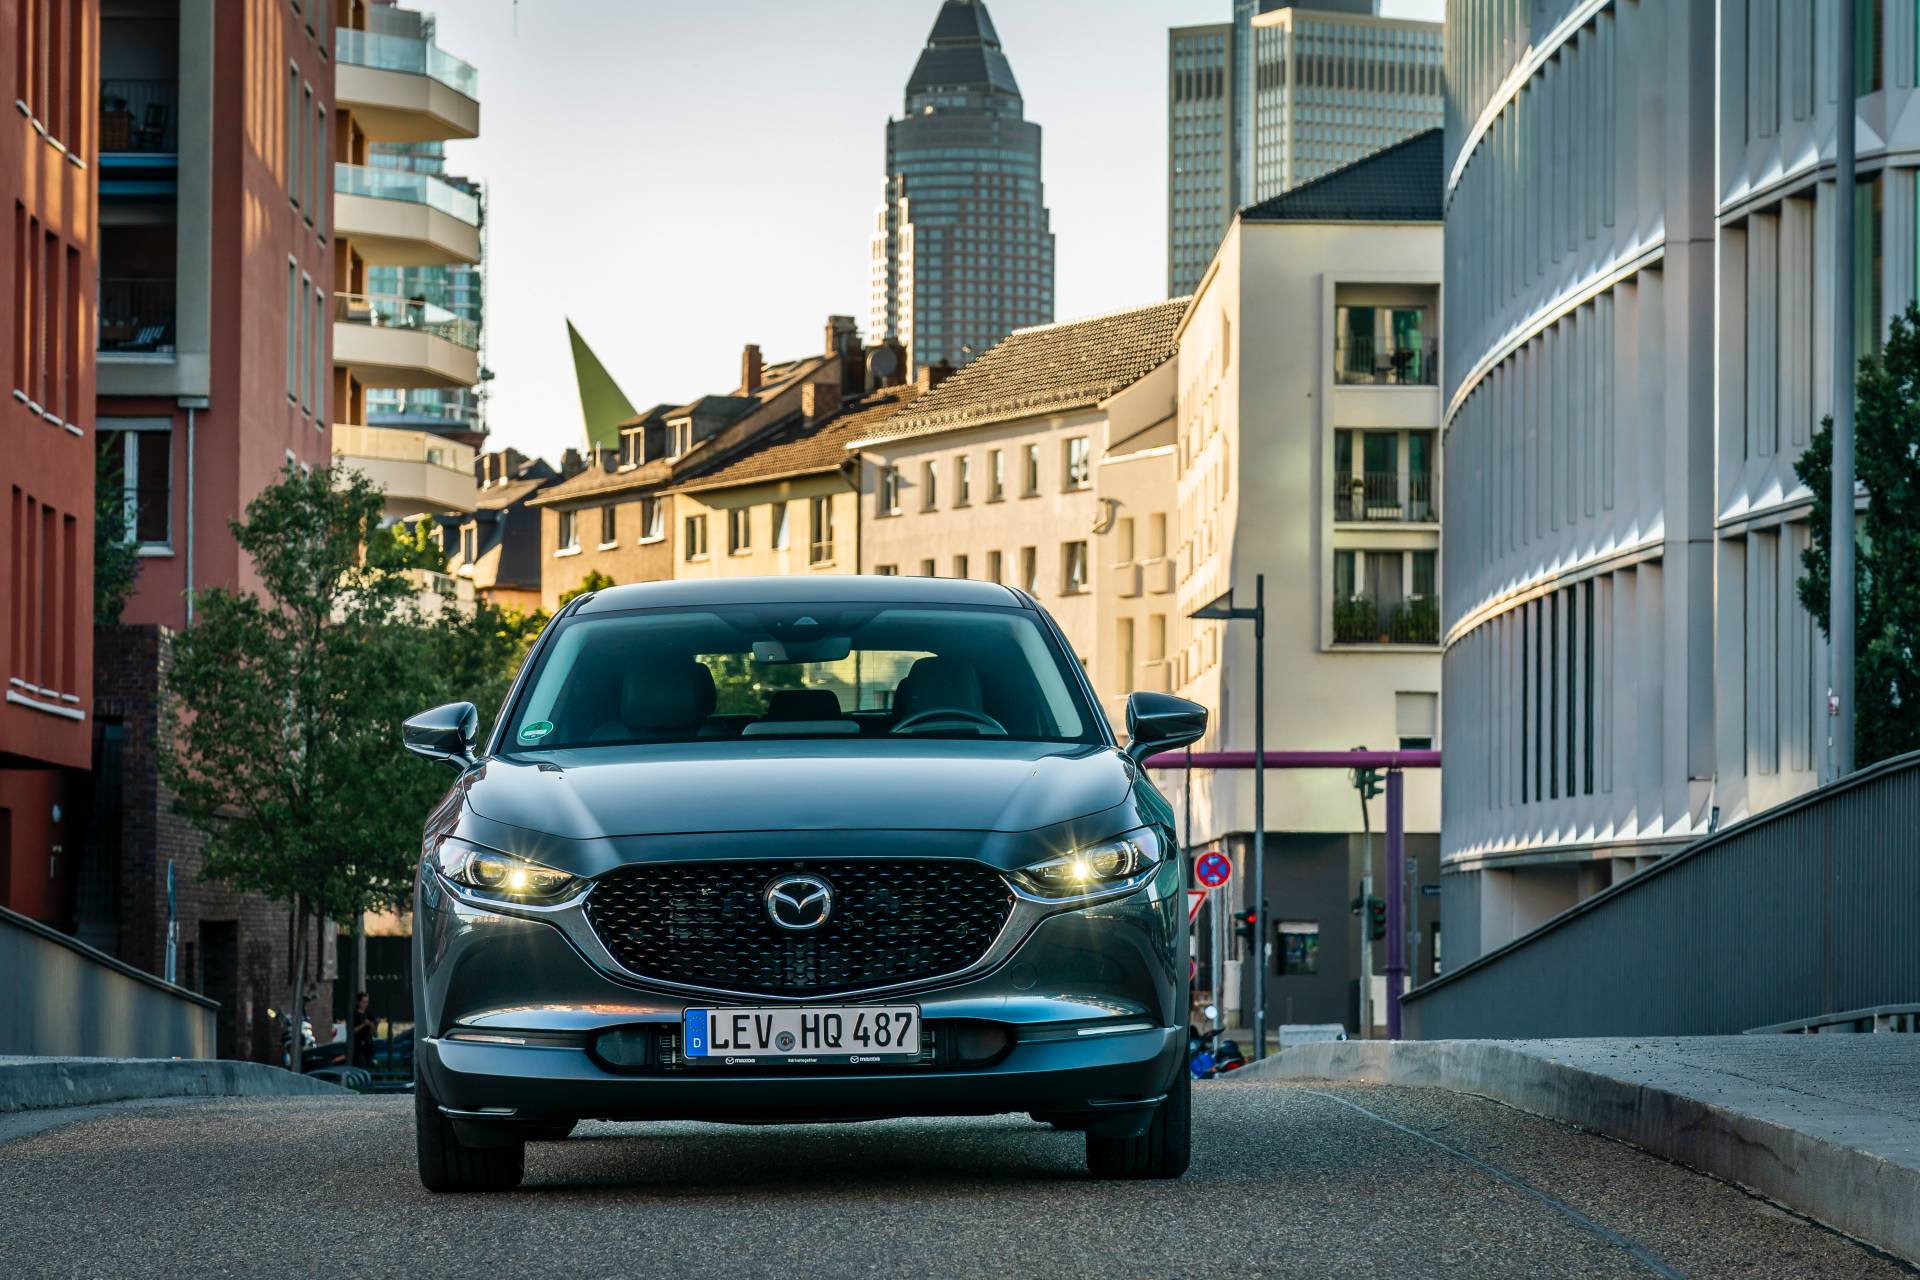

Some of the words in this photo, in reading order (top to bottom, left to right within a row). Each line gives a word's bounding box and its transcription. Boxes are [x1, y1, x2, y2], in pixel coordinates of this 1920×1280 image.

[710, 1013, 773, 1049] LEV
[801, 1013, 842, 1048] HQ
[853, 1012, 912, 1048] 487
[693, 1038, 701, 1048] D
